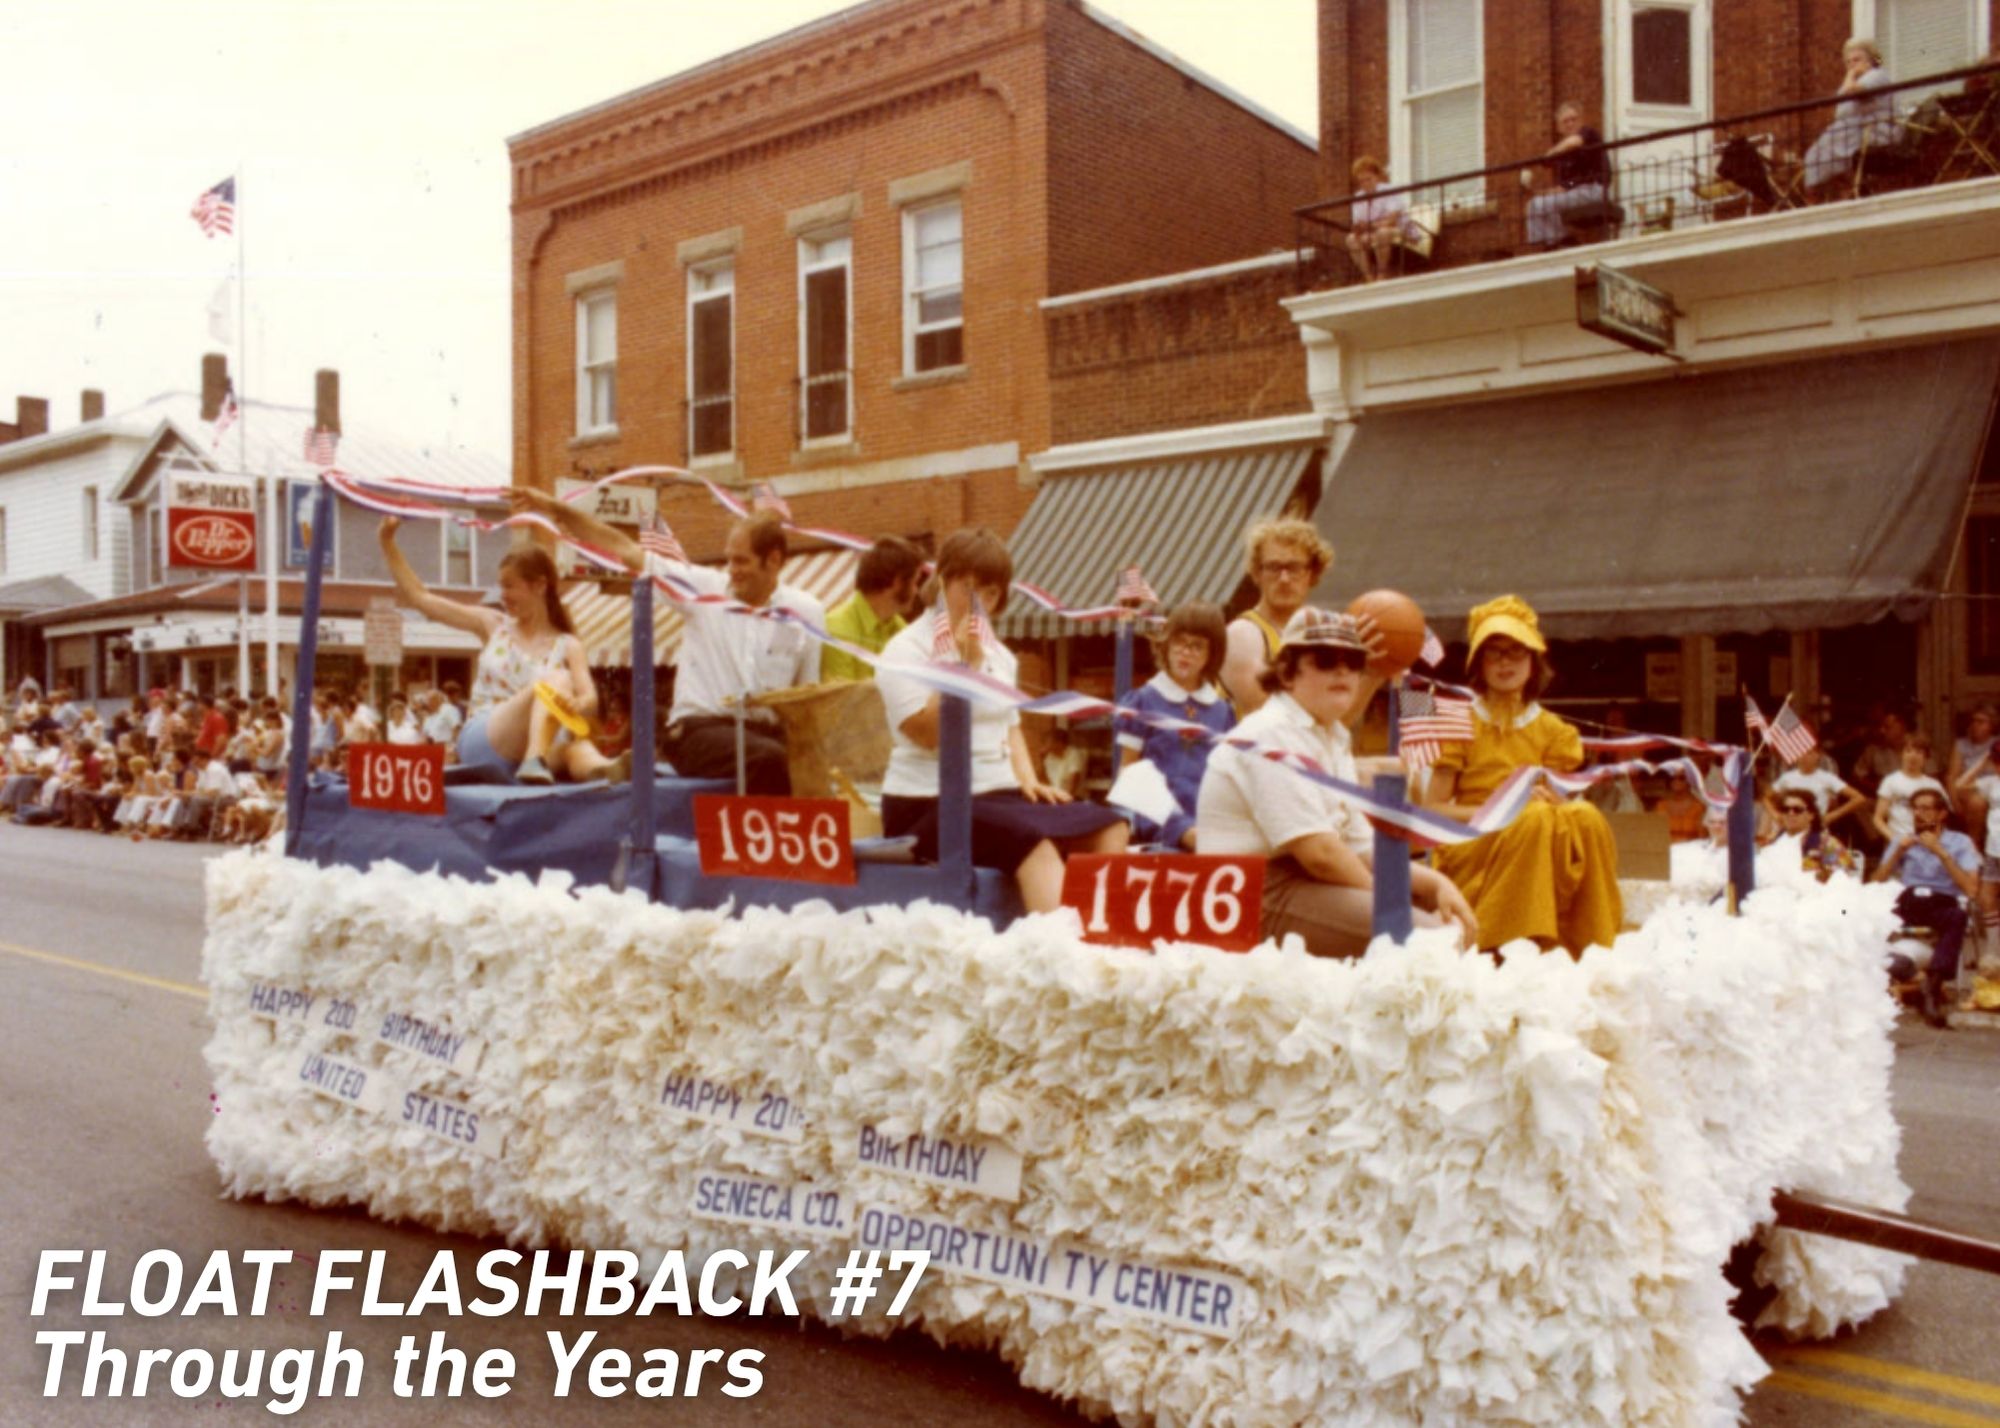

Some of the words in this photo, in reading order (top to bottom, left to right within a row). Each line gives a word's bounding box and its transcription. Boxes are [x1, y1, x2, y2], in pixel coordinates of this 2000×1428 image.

[361, 754, 432, 802] 1976
[718, 808, 840, 869] 1956
[1087, 861, 1246, 936] 1776
[251, 984, 317, 1019] HAPPY
[380, 1012, 464, 1063] BIRTHDAY
[300, 1053, 366, 1099] UNITED
[661, 1074, 742, 1121] HAPPY
[403, 1091, 478, 1143] STATES
[858, 1124, 986, 1184] BIRTHDAY
[697, 1177, 793, 1224] SENECA
[803, 1192, 844, 1230] CO.
[1113, 1263, 1233, 1327] CENTER
